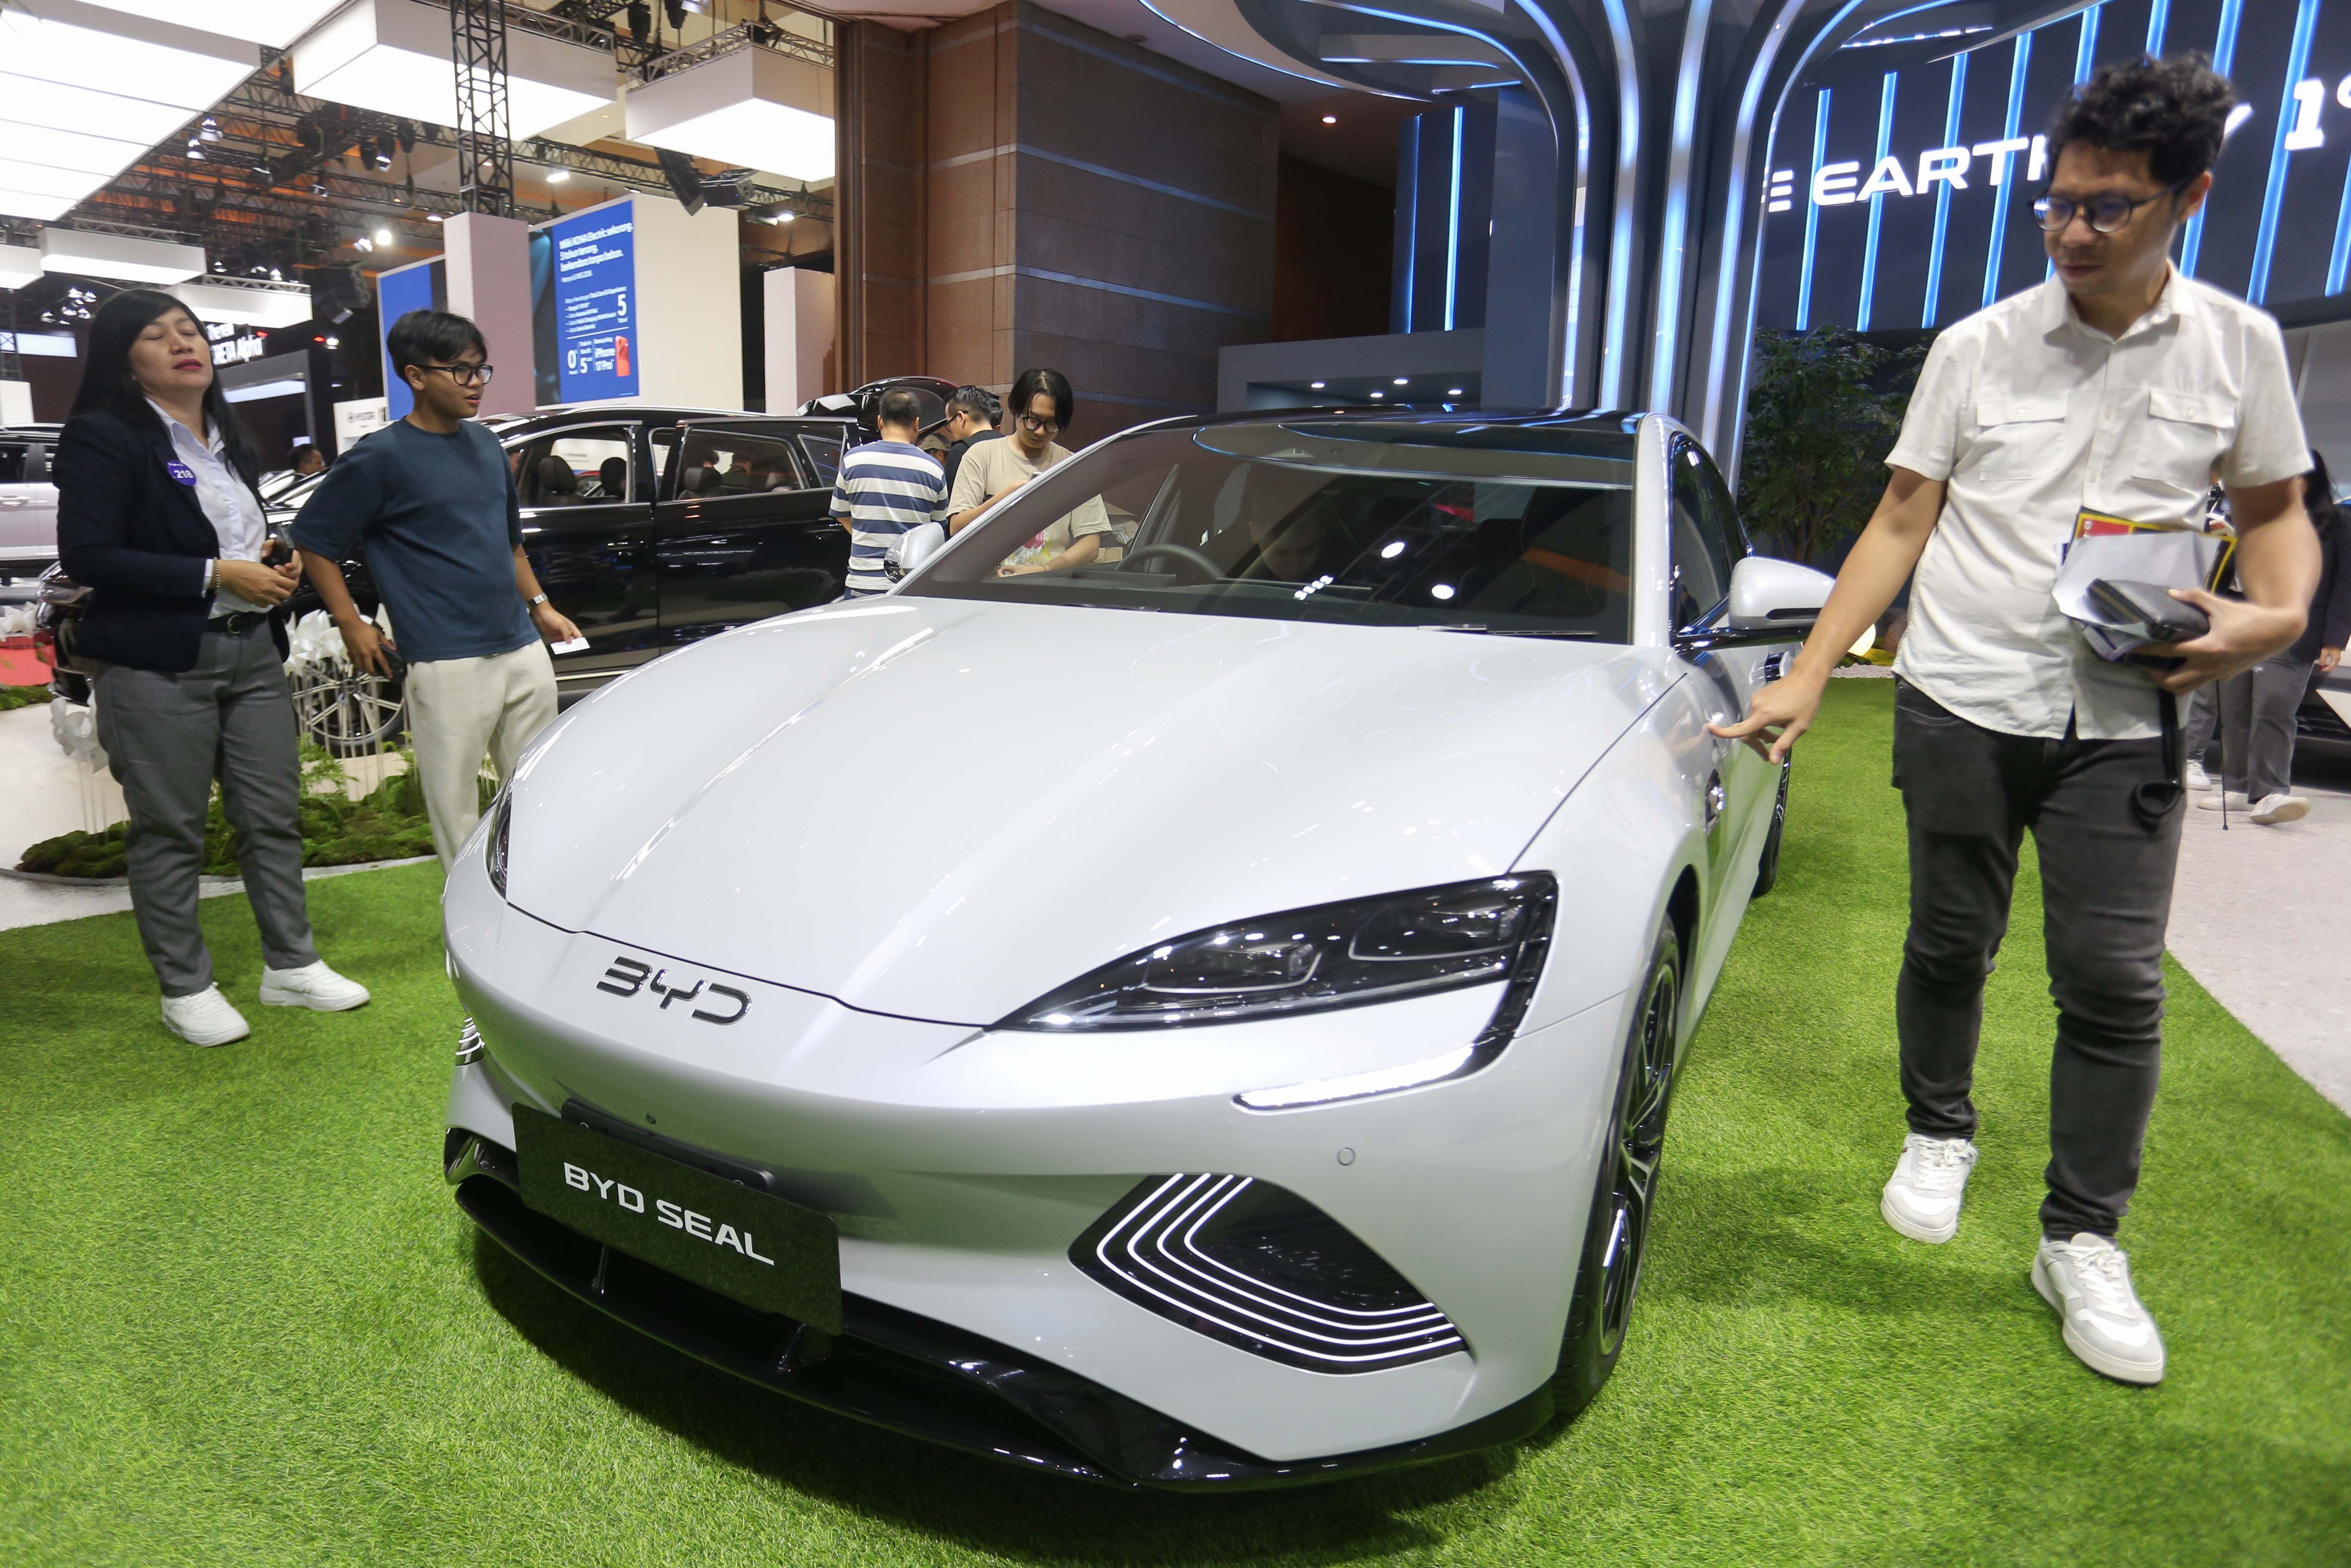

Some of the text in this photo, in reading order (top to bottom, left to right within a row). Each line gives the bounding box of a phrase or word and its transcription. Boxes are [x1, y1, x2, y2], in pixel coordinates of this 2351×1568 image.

[618, 294, 627, 316] 5
[210, 340, 237, 365] RETA
[596, 955, 753, 1026] BYD
[563, 1161, 775, 1266] BYD SEAL
